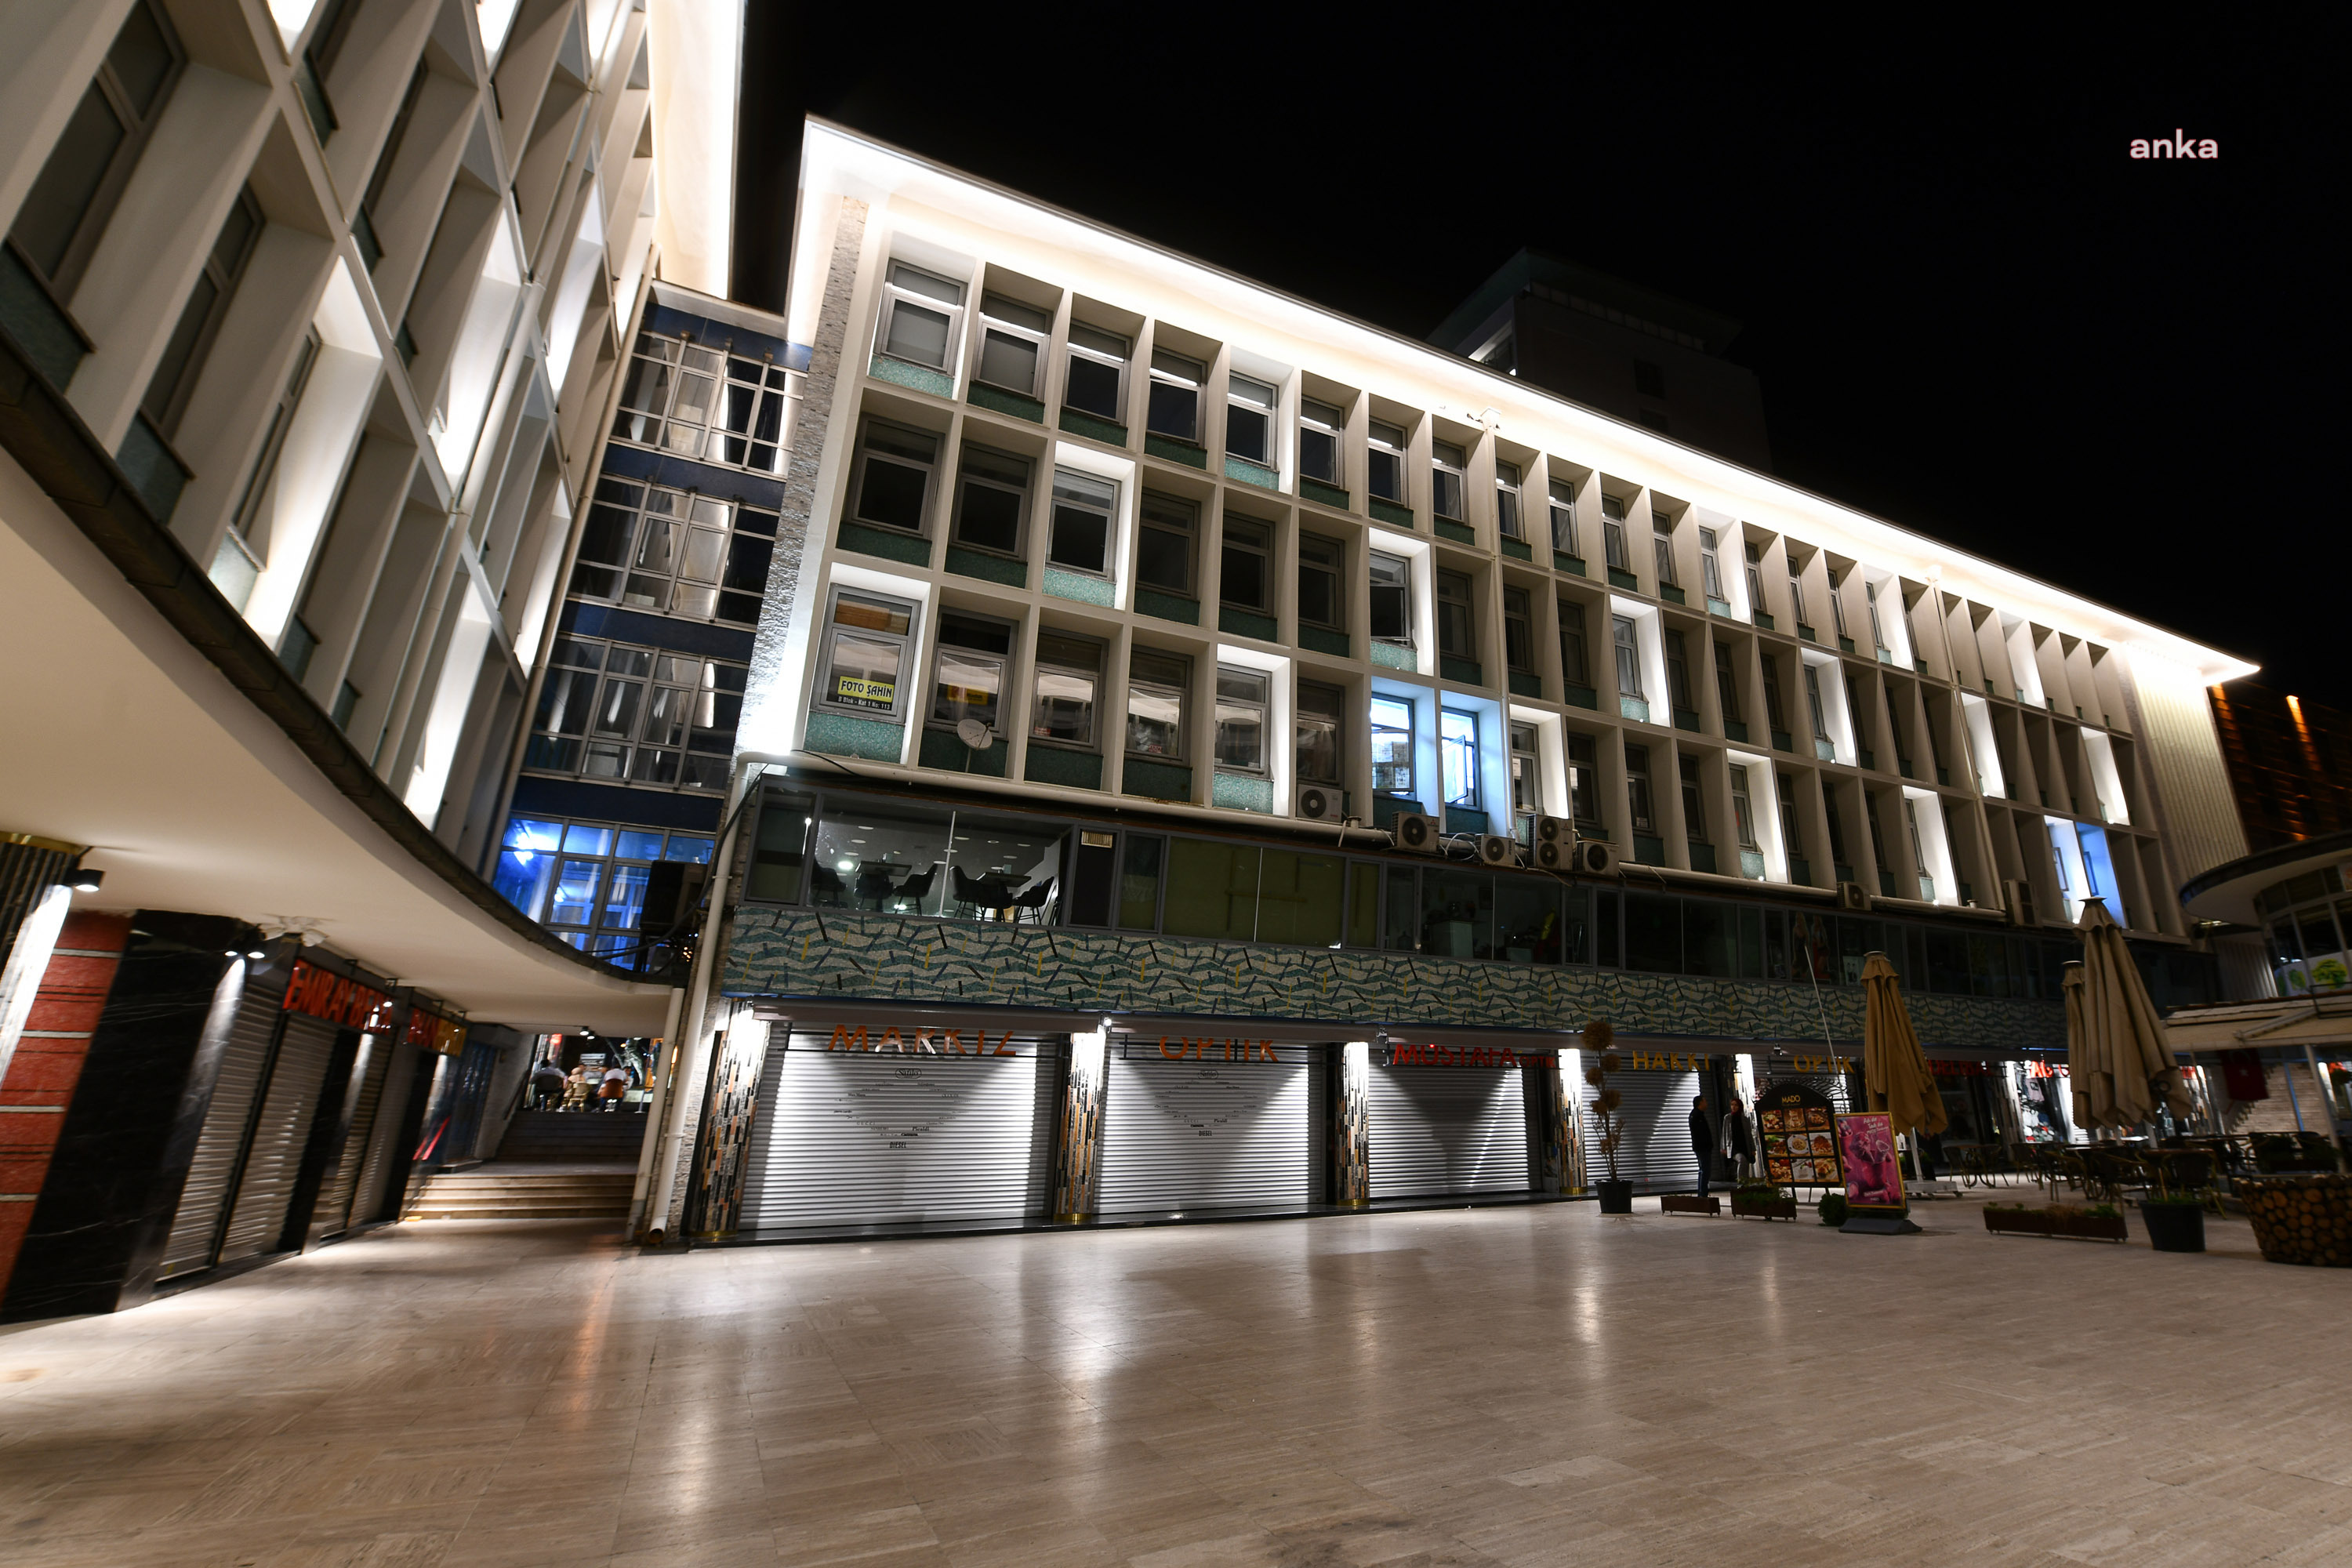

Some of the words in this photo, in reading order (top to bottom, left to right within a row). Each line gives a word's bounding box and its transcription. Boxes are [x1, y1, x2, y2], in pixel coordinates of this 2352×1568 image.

[841, 681, 864, 692] FOTO
[866, 684, 892, 698] ŞAHİN
[1781, 1094, 1801, 1104] MADO
